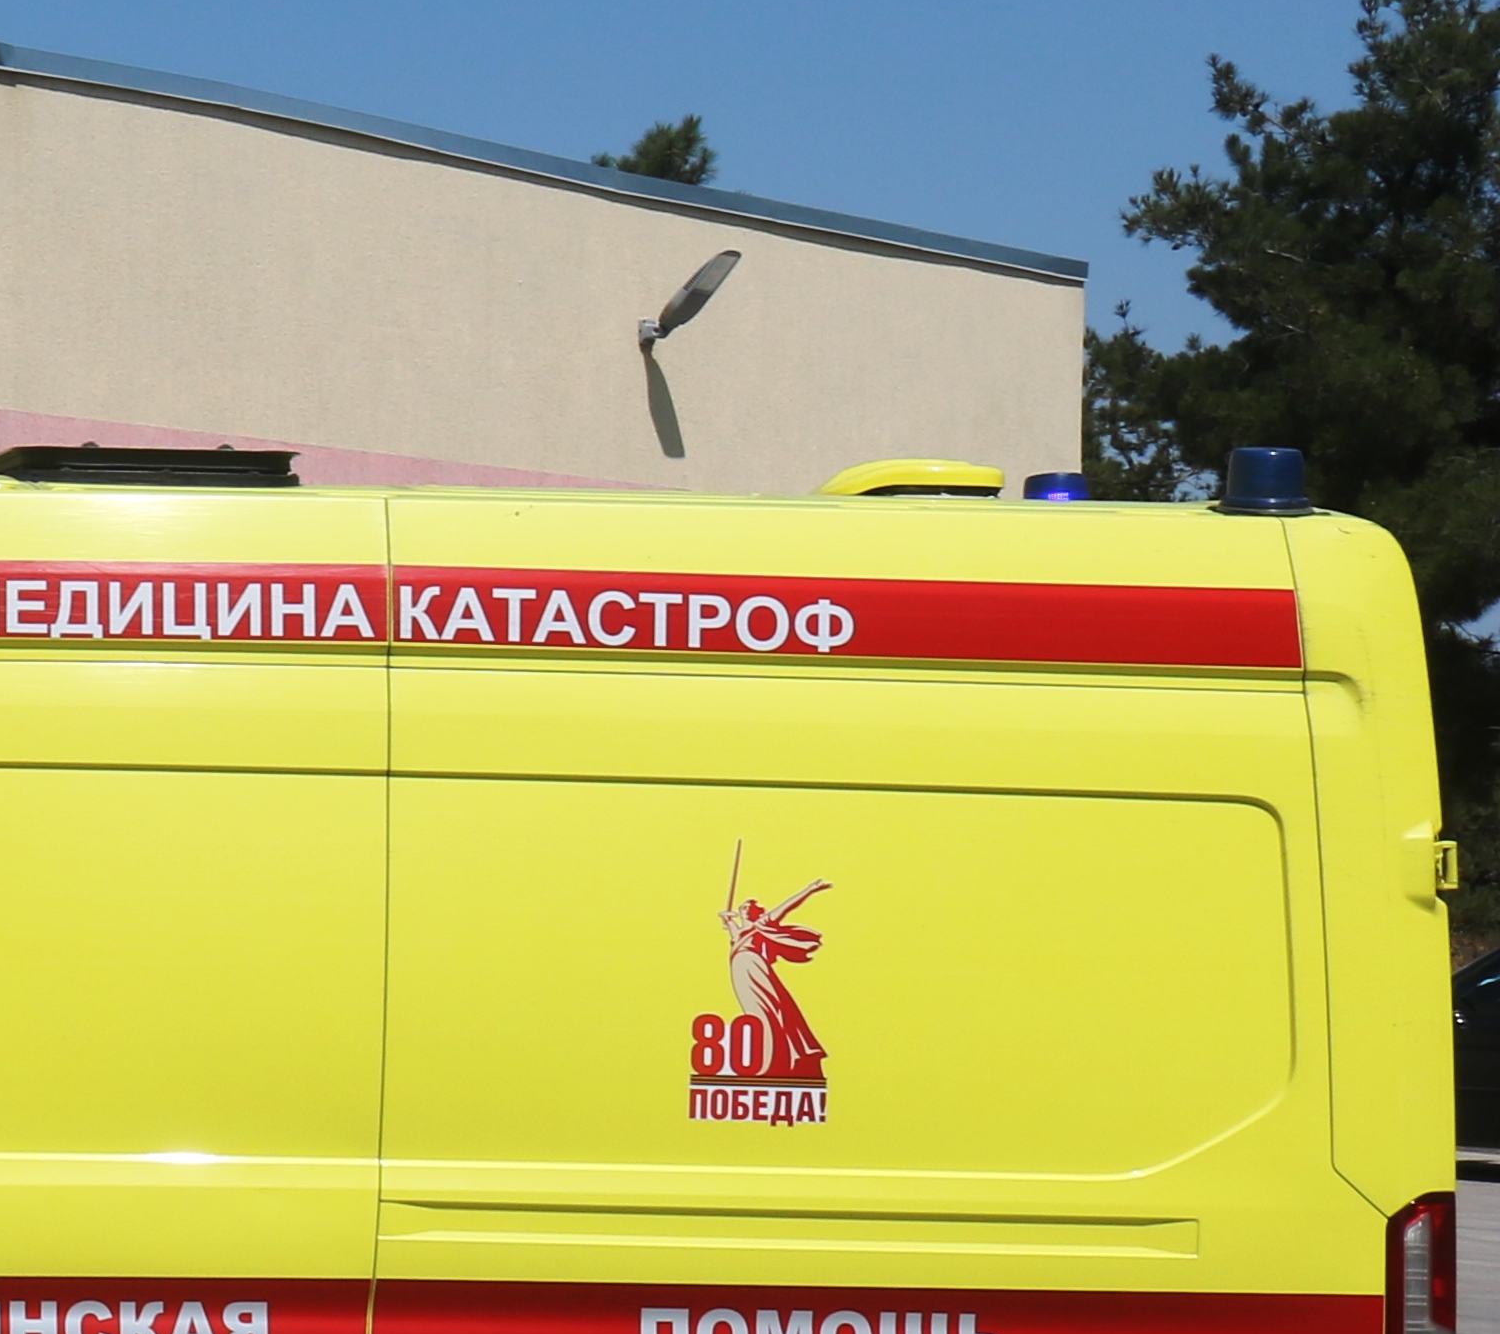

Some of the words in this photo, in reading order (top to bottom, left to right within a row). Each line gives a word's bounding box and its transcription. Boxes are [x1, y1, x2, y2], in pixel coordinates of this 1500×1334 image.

[399, 585, 855, 653] КАТАСТРОФ
[690, 1013, 765, 1077] 80
[688, 1088, 828, 1127] ПОБЕДА!
